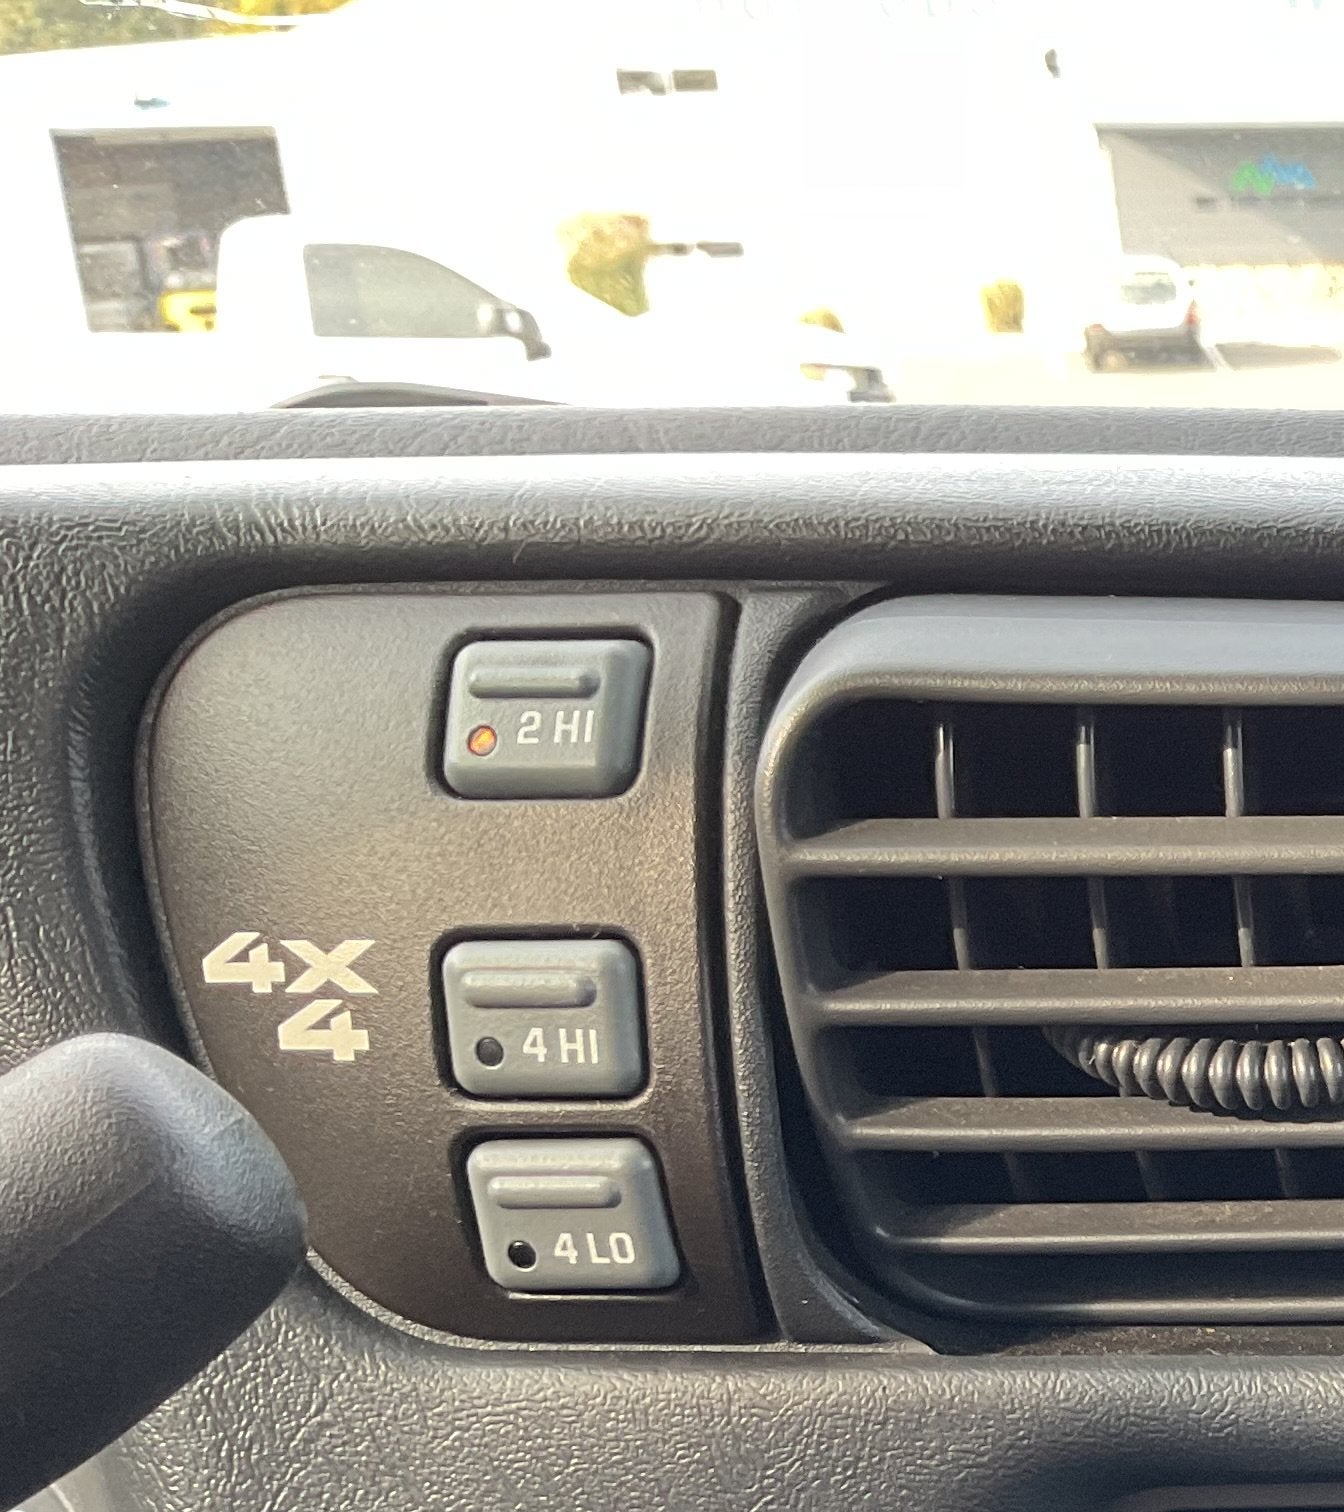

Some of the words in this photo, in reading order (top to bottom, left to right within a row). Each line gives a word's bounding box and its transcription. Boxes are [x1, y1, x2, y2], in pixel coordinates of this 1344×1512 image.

[517, 711, 541, 744] 2
[554, 710, 594, 744] HI
[278, 999, 370, 1063] 4
[523, 1028, 547, 1062] 4
[559, 1028, 598, 1064] HI
[554, 1233, 578, 1264] 4
[589, 1233, 635, 1264] LO
